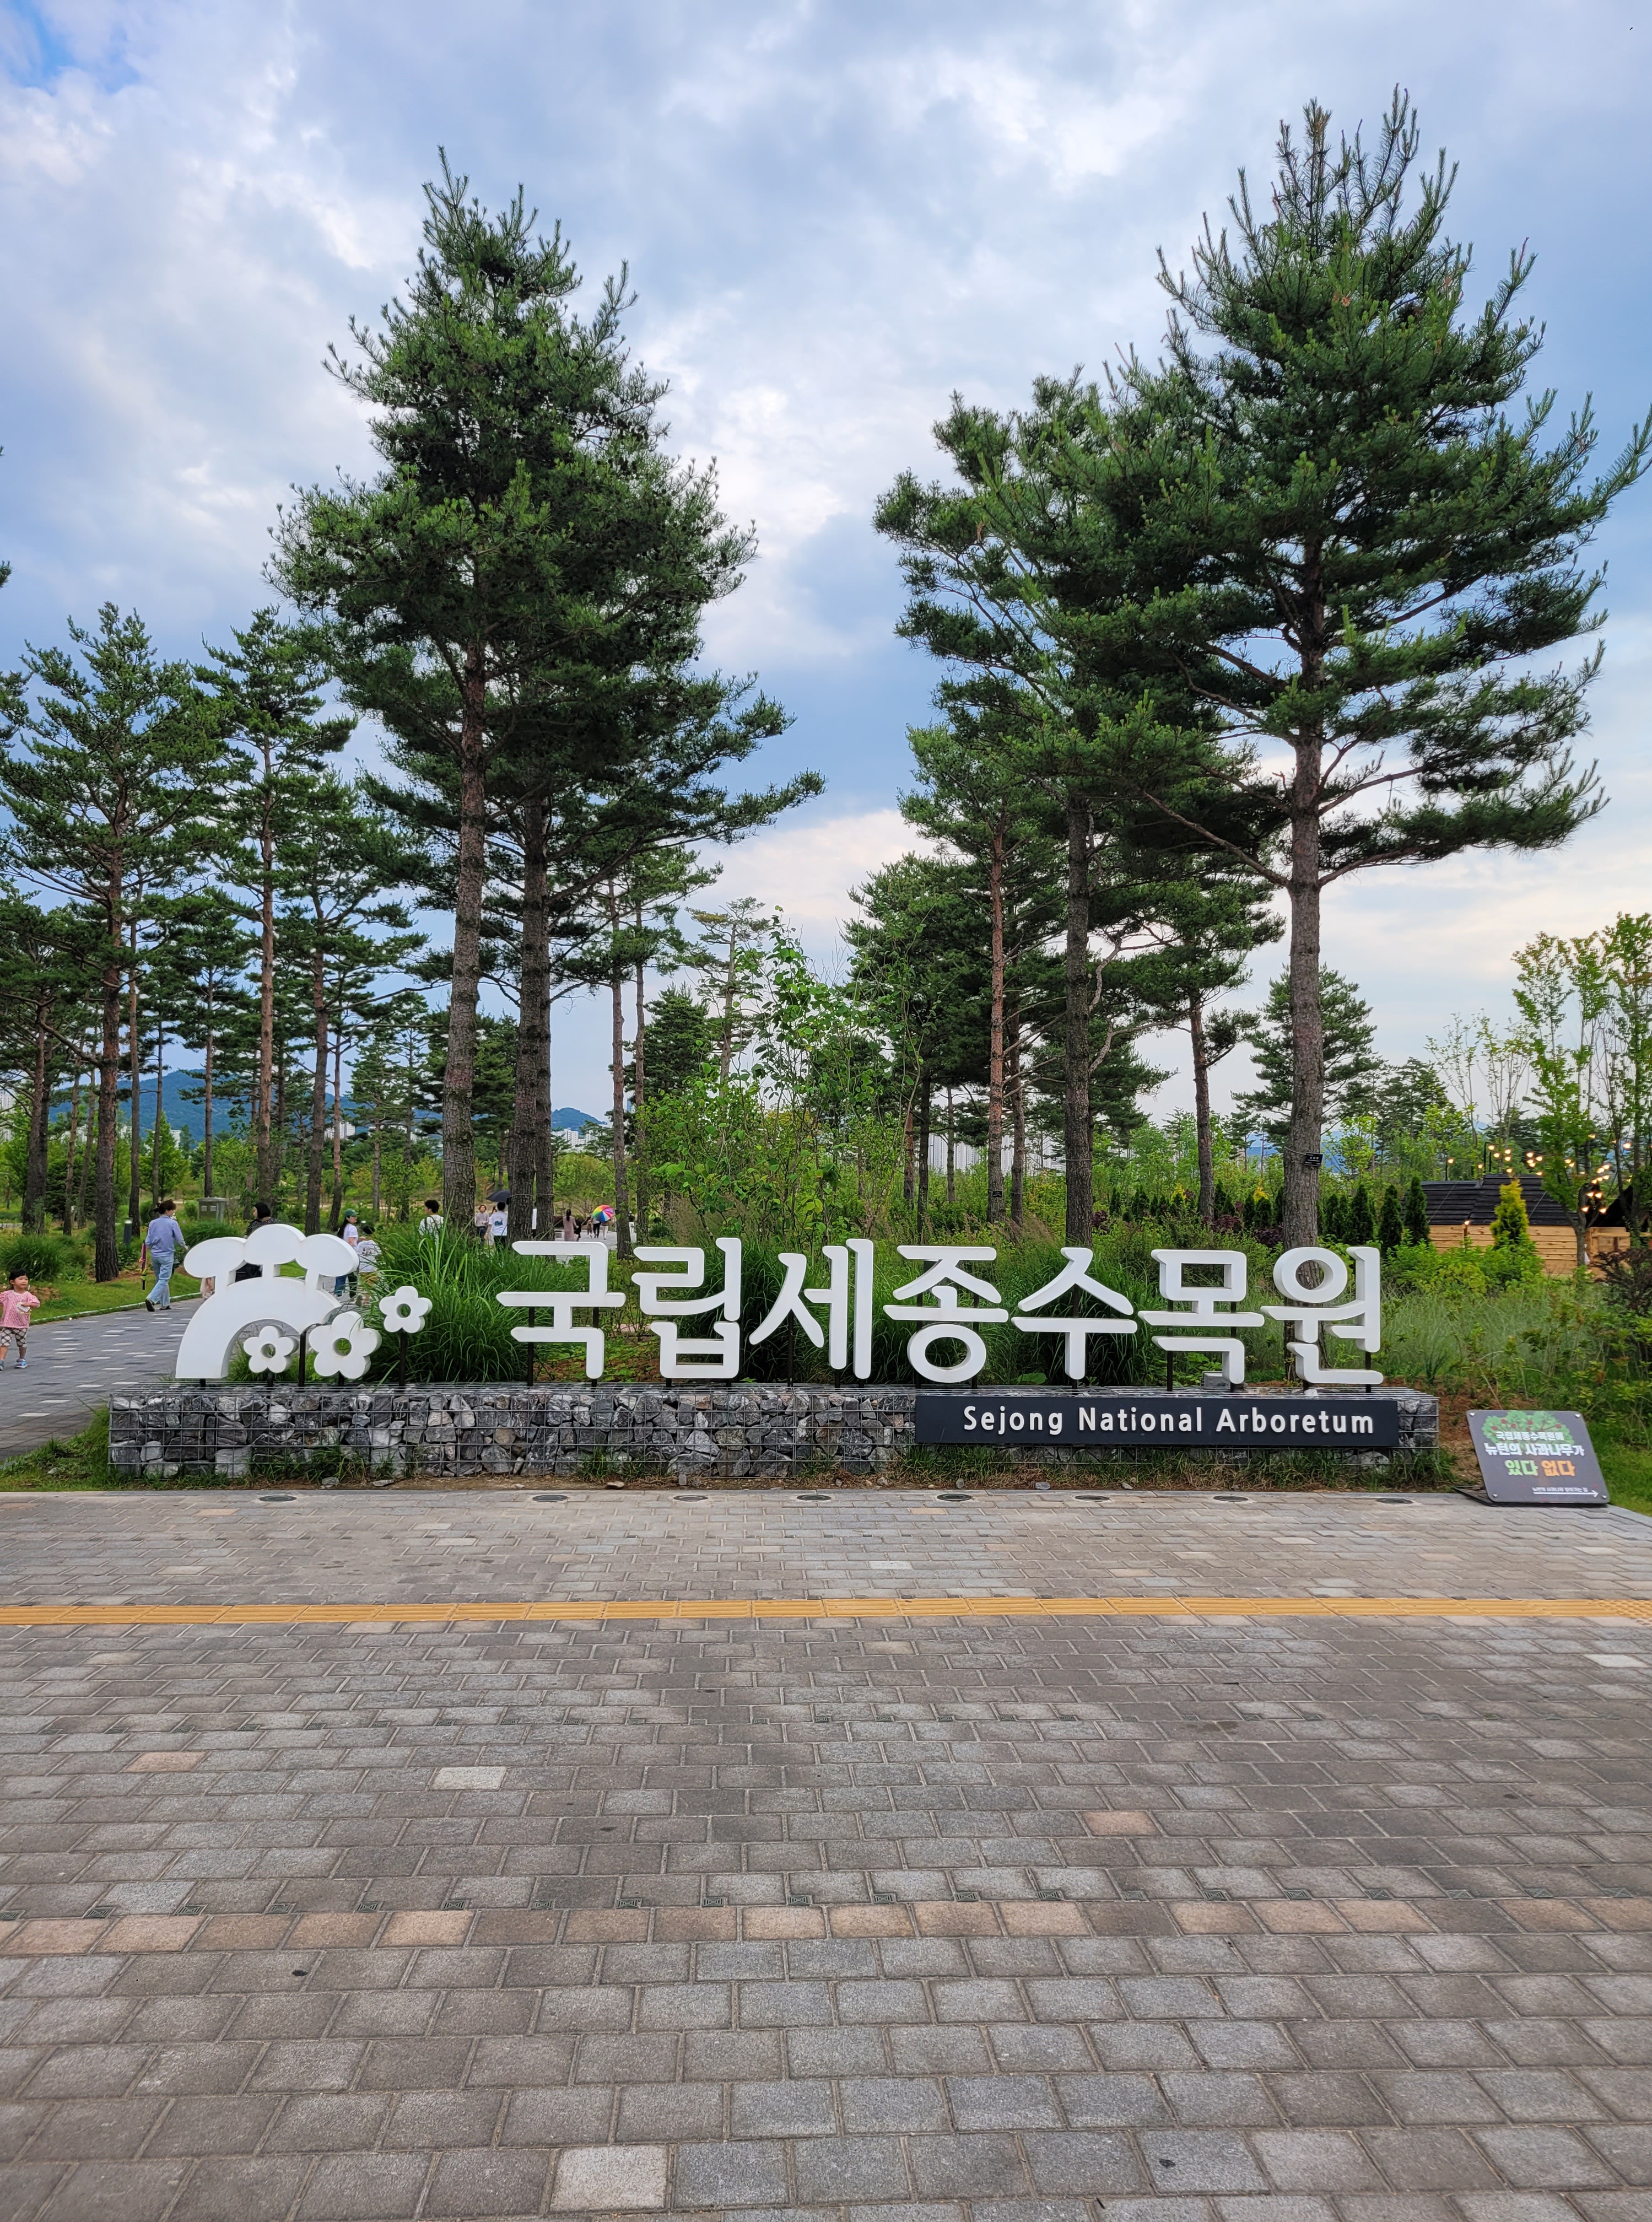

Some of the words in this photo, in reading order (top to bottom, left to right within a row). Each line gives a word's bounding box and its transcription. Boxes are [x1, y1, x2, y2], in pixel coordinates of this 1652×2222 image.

[496, 1238, 1384, 1384] 국립세종수목원
[964, 1406, 1062, 1435] Sejong
[1079, 1407, 1202, 1432] National
[1216, 1407, 1373, 1433] Arboretum
[1496, 1431, 1565, 1441] 국립세종수목원에
[1483, 1443, 1523, 1455] 뉴턴의
[1525, 1443, 1585, 1456] 사과나무가
[1504, 1460, 1538, 1476] 있다
[1541, 1460, 1575, 1476] 없다
